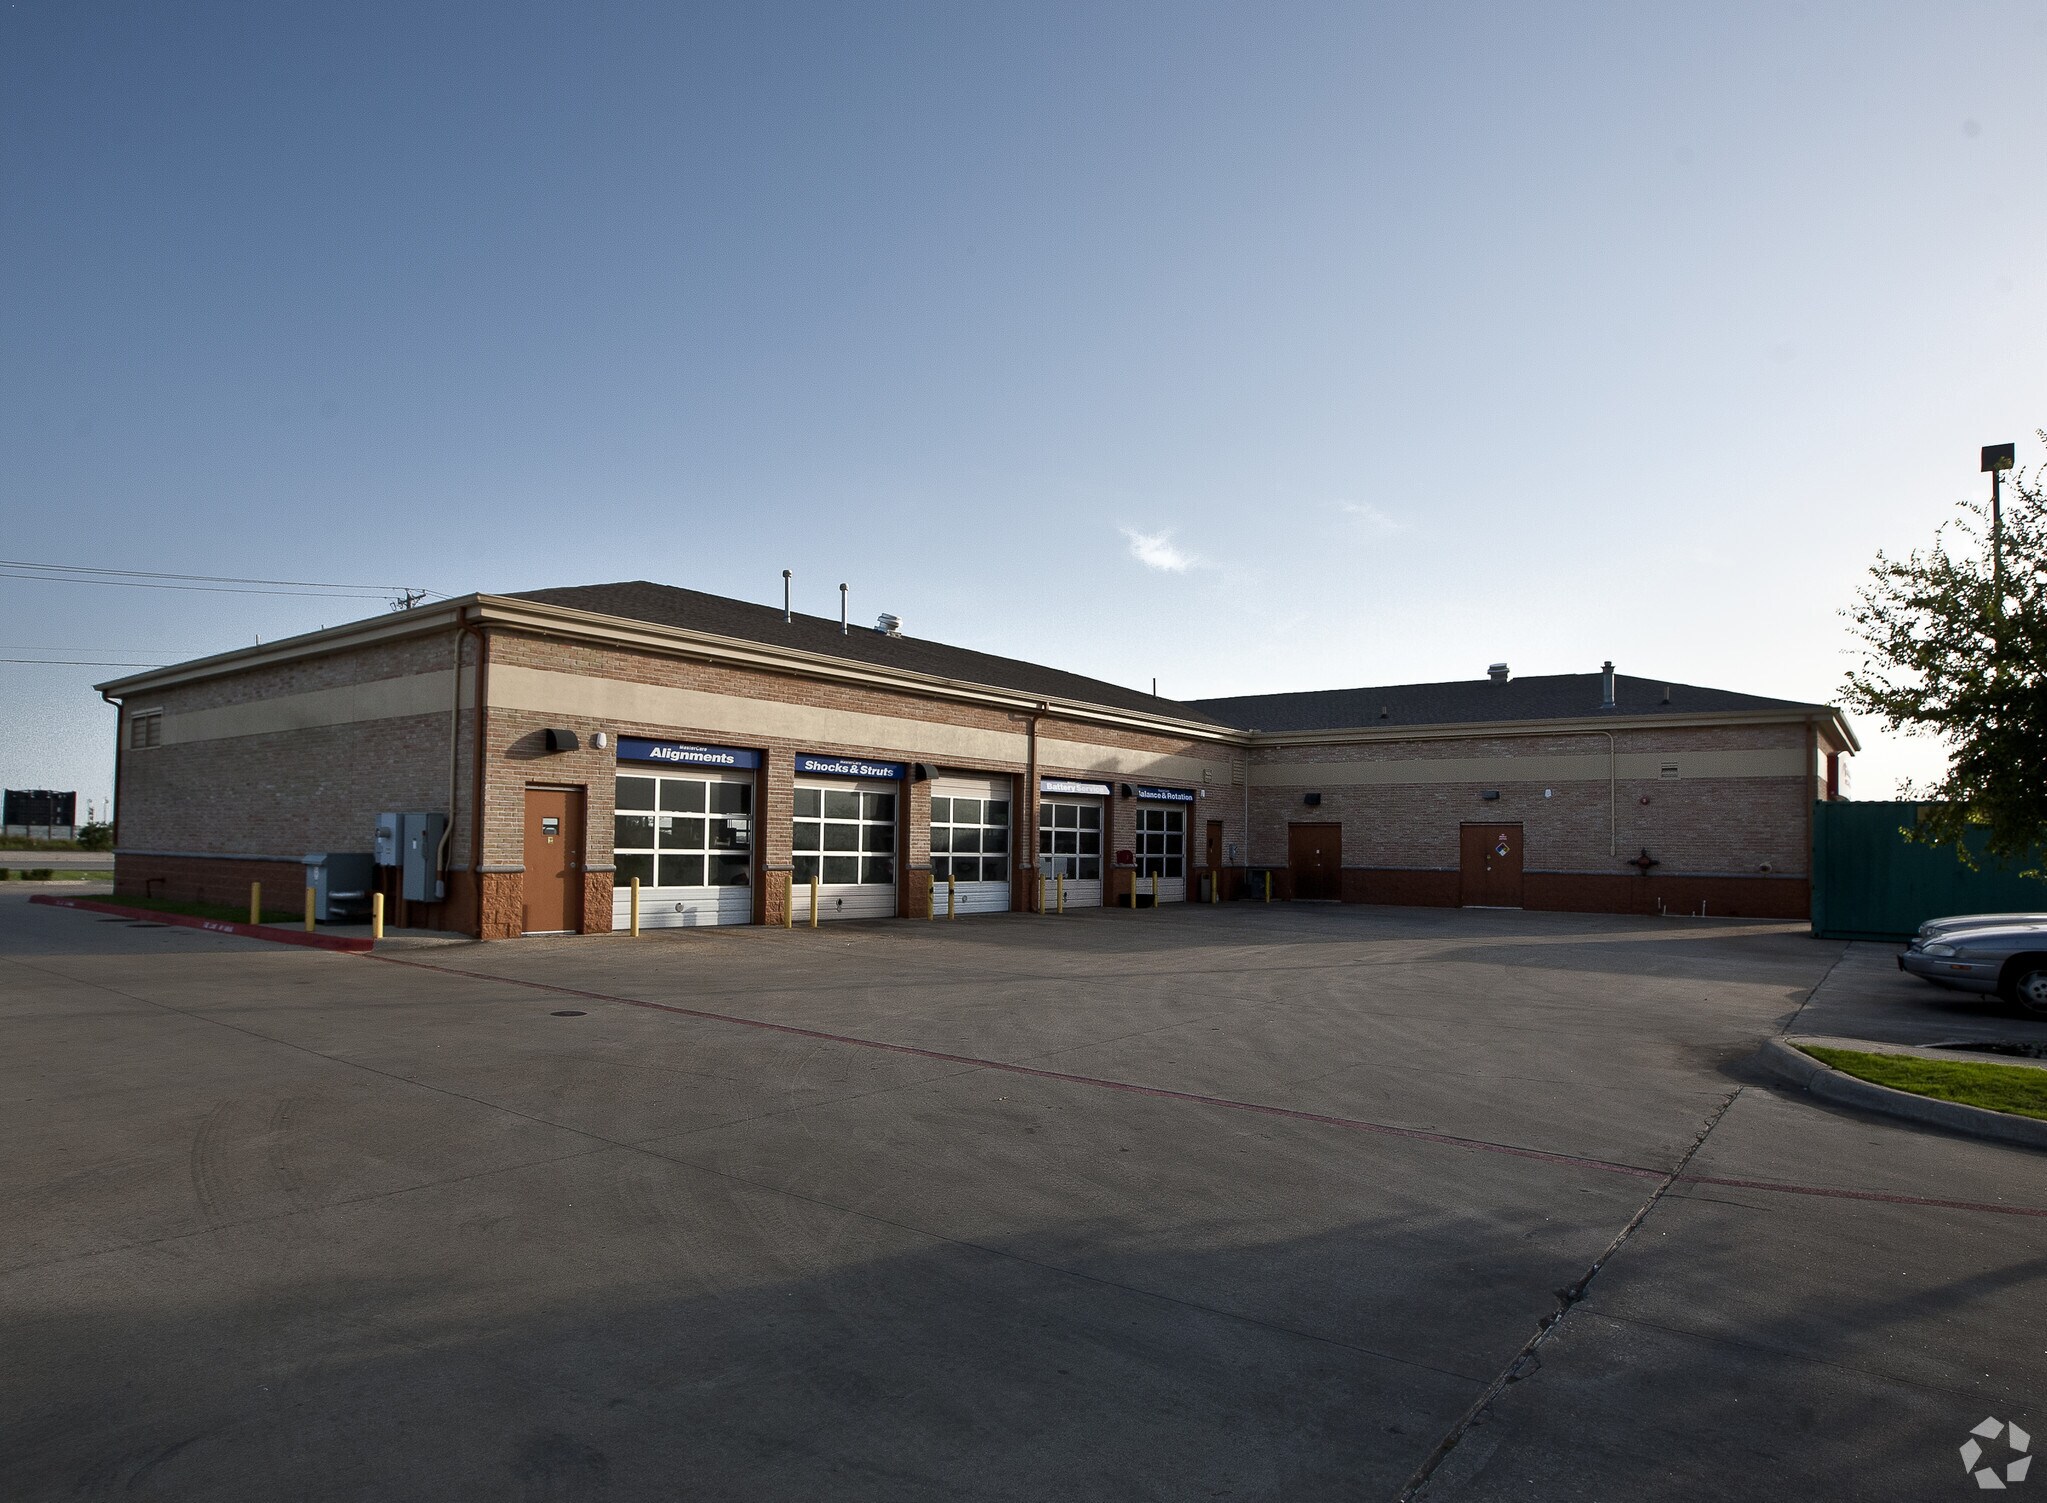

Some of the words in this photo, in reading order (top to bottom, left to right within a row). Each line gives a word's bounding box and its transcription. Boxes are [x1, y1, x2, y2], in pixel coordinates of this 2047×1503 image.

[650, 747, 735, 764] Alignments
[804, 760, 849, 774] Shocks
[849, 764, 859, 774] &
[860, 765, 894, 777] Struts
[1046, 782, 1076, 793] Battery
[1076, 784, 1104, 794] Service
[1167, 792, 1193, 801] Rotation
